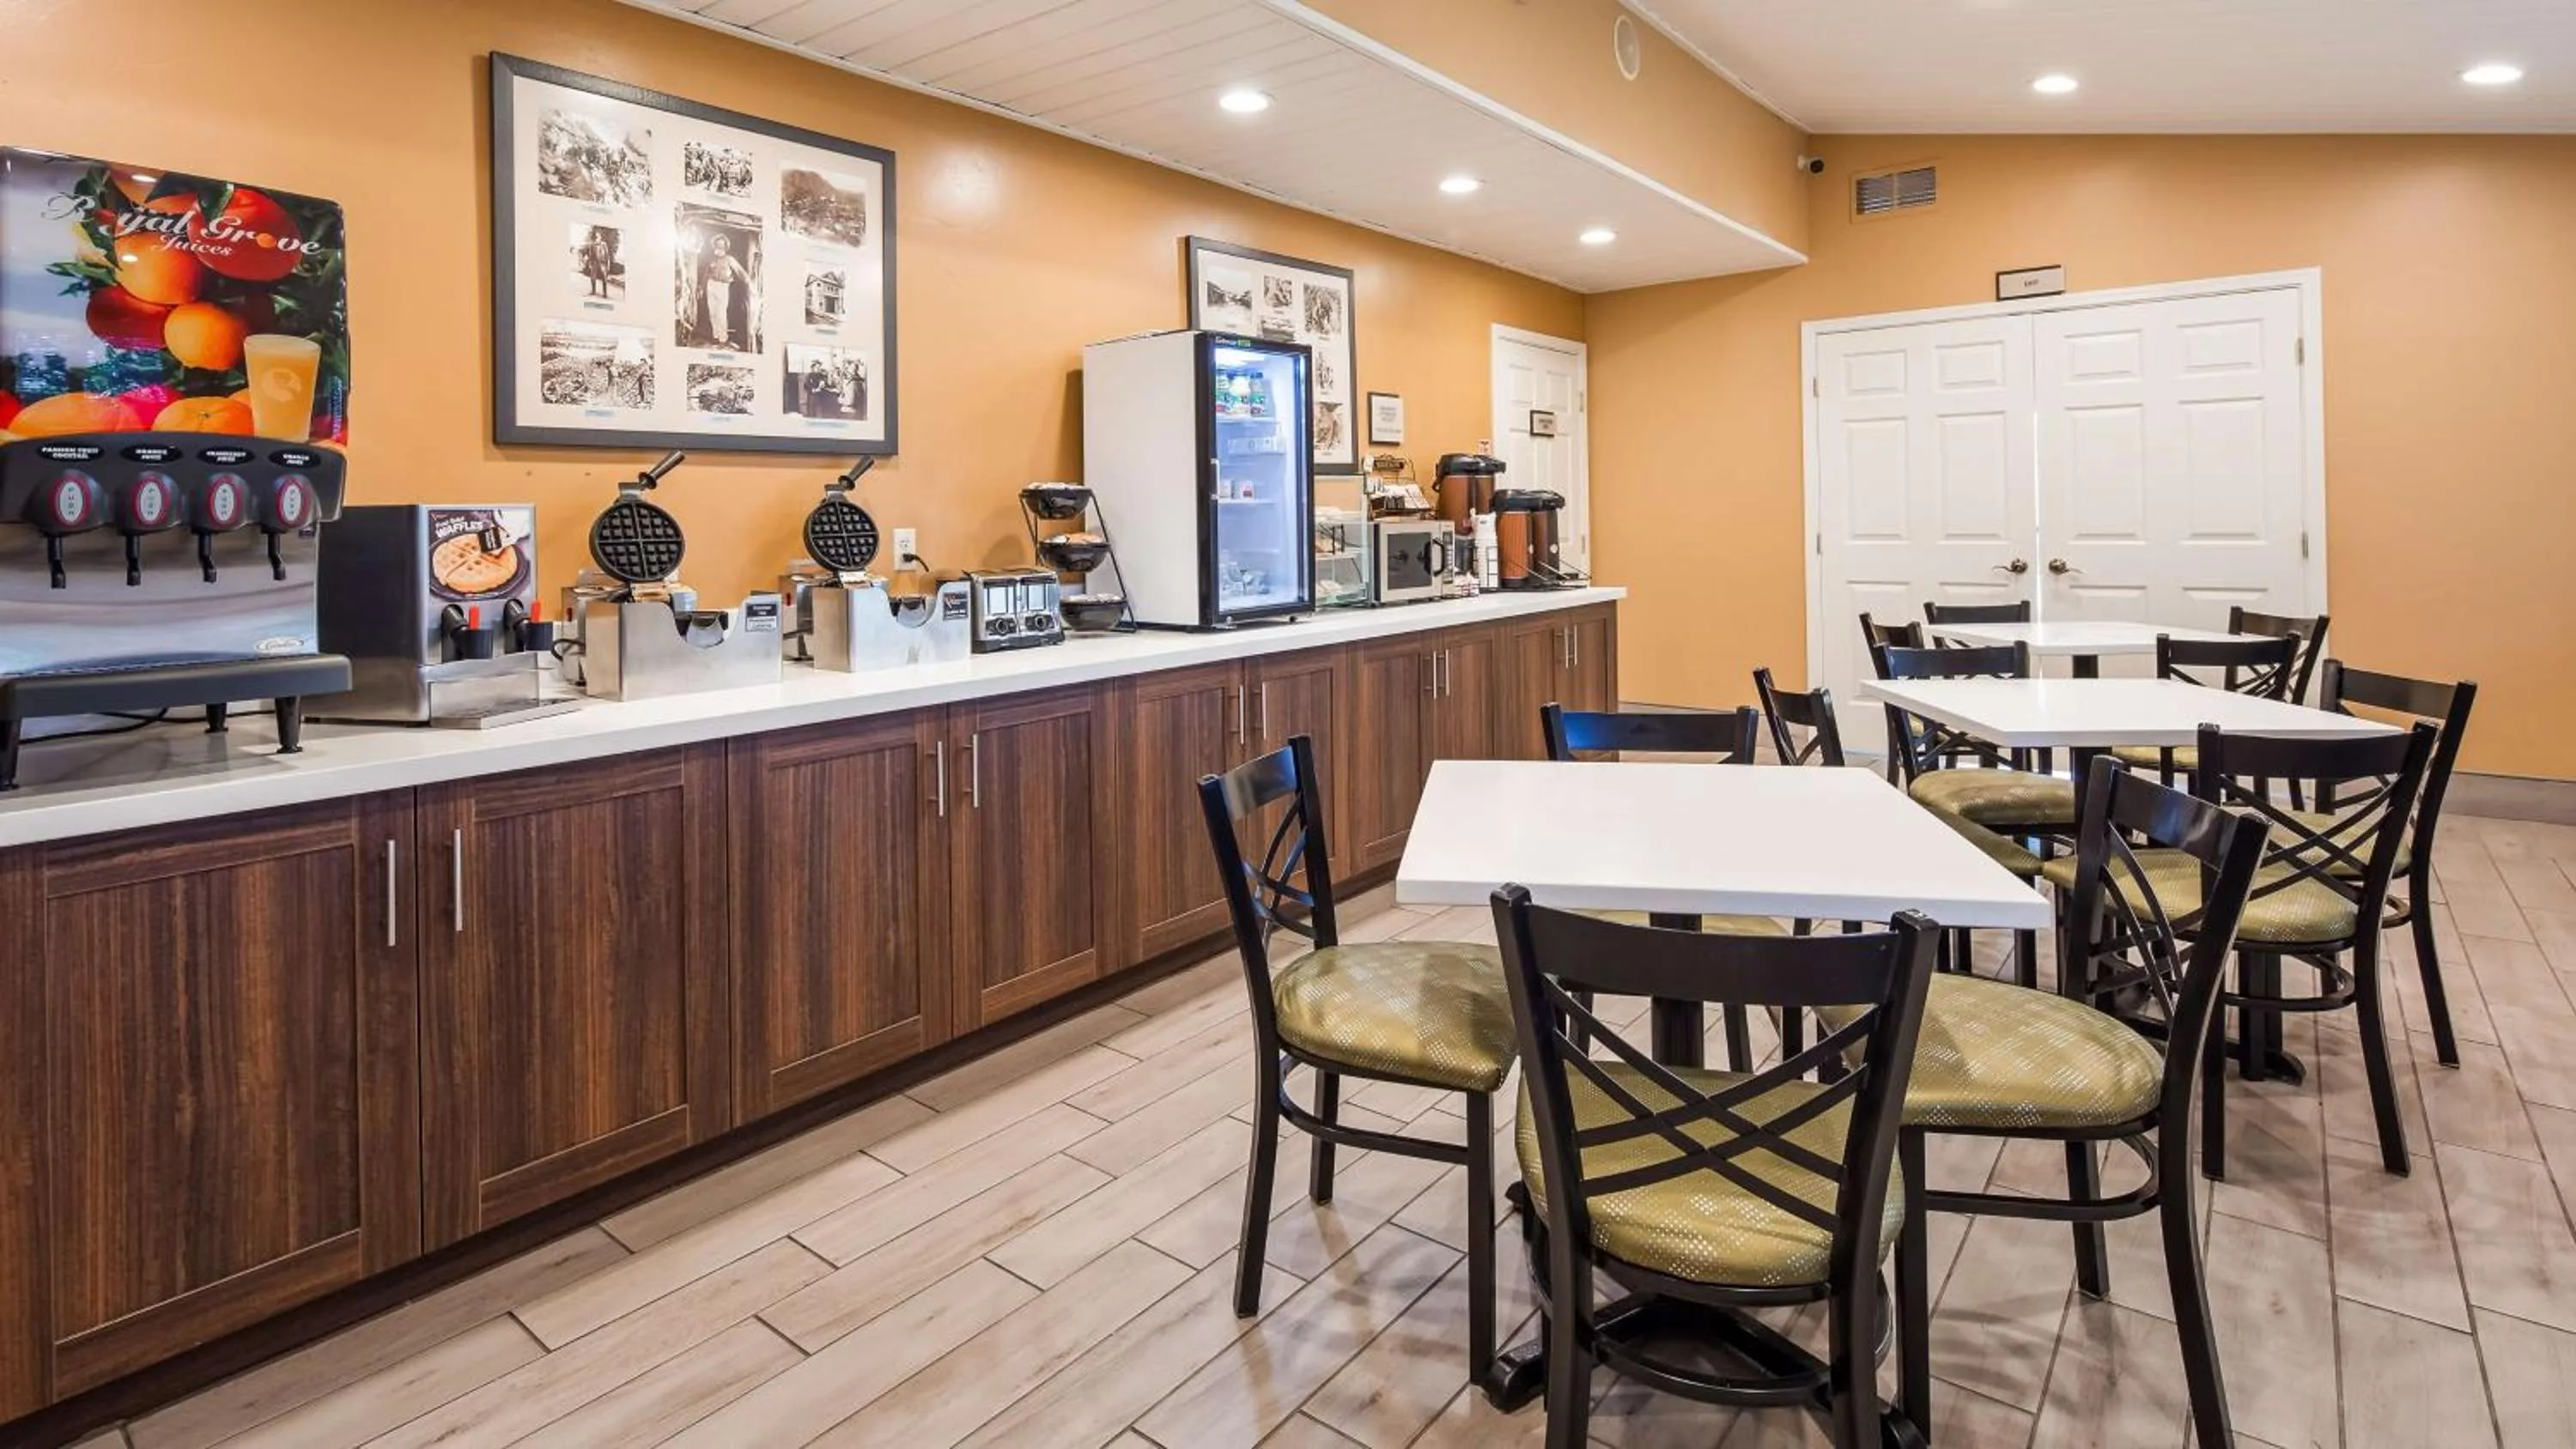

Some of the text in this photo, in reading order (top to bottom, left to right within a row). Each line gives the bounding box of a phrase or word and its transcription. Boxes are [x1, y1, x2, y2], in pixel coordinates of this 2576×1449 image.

[149, 233, 234, 257] Juices
[200, 215, 322, 255] Grove
[435, 521, 483, 538] WAFFLES
